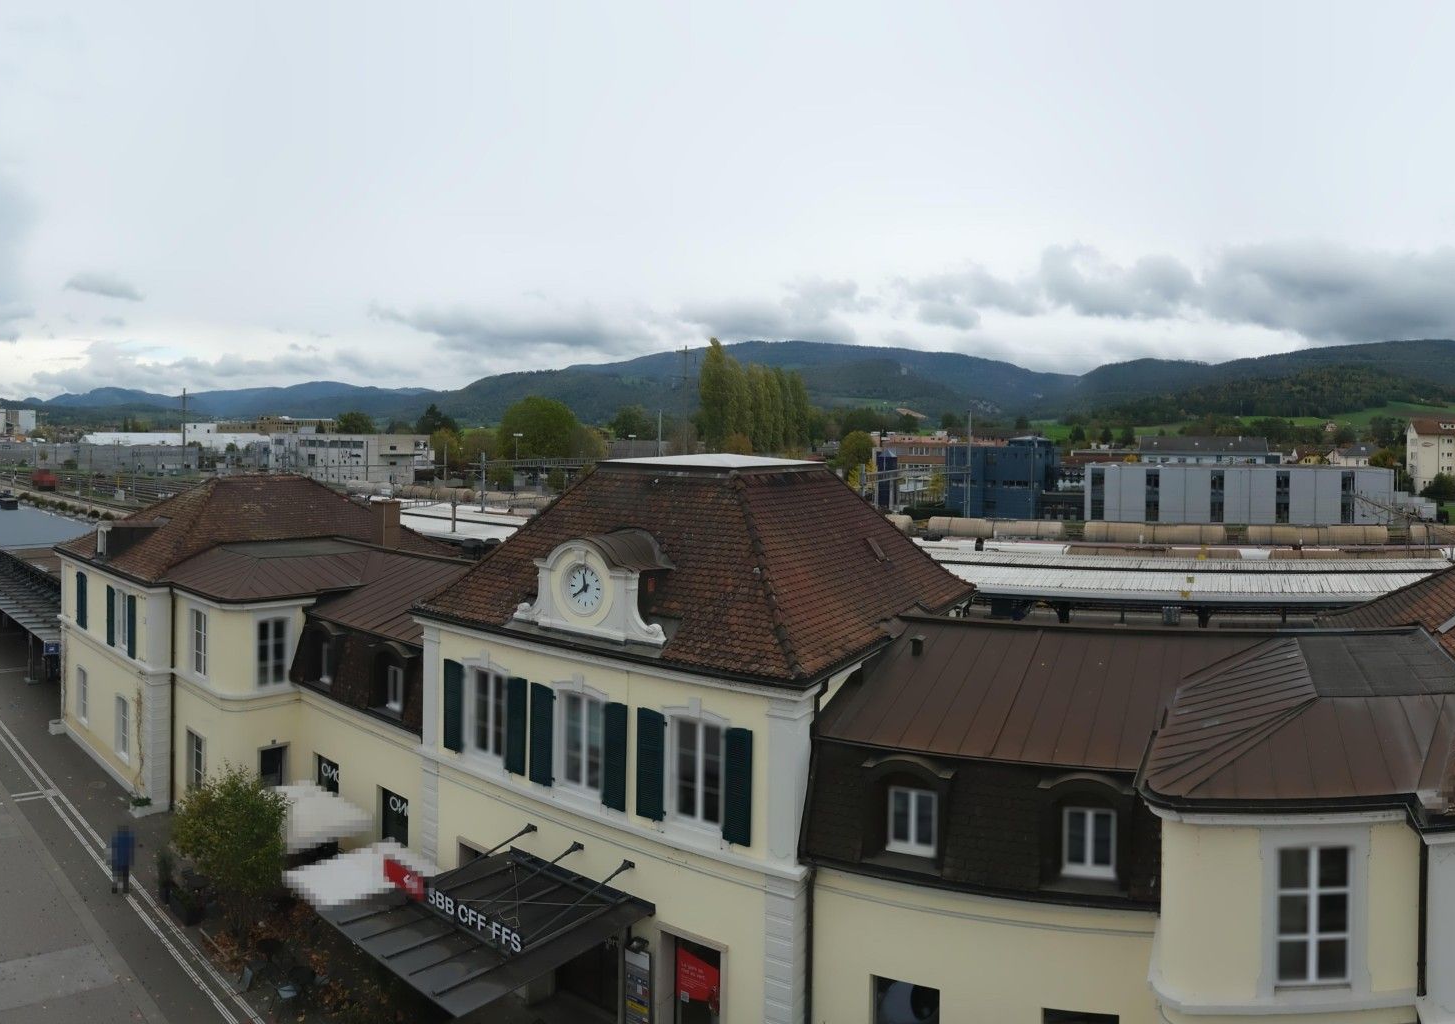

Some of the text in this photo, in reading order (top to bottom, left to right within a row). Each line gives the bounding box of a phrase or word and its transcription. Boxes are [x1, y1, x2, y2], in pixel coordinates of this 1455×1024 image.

[428, 888, 522, 953] SBB CFF FFS
